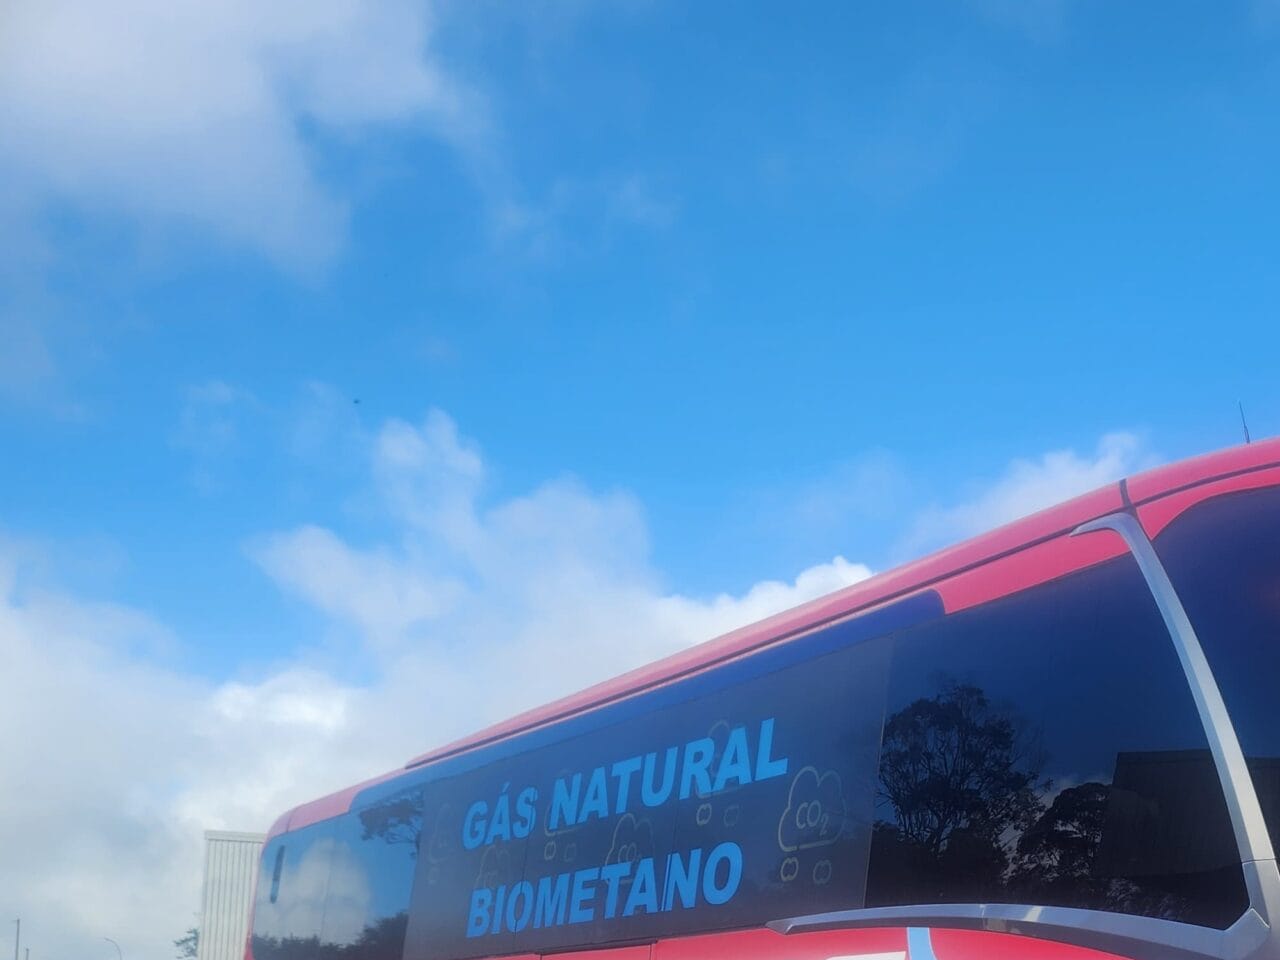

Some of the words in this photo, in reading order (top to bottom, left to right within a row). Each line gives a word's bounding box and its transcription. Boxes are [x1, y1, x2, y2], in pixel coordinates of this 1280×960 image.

[462, 782, 537, 850] GÁS
[549, 718, 788, 830] NATURAL
[466, 841, 743, 938] BIOMETANO
